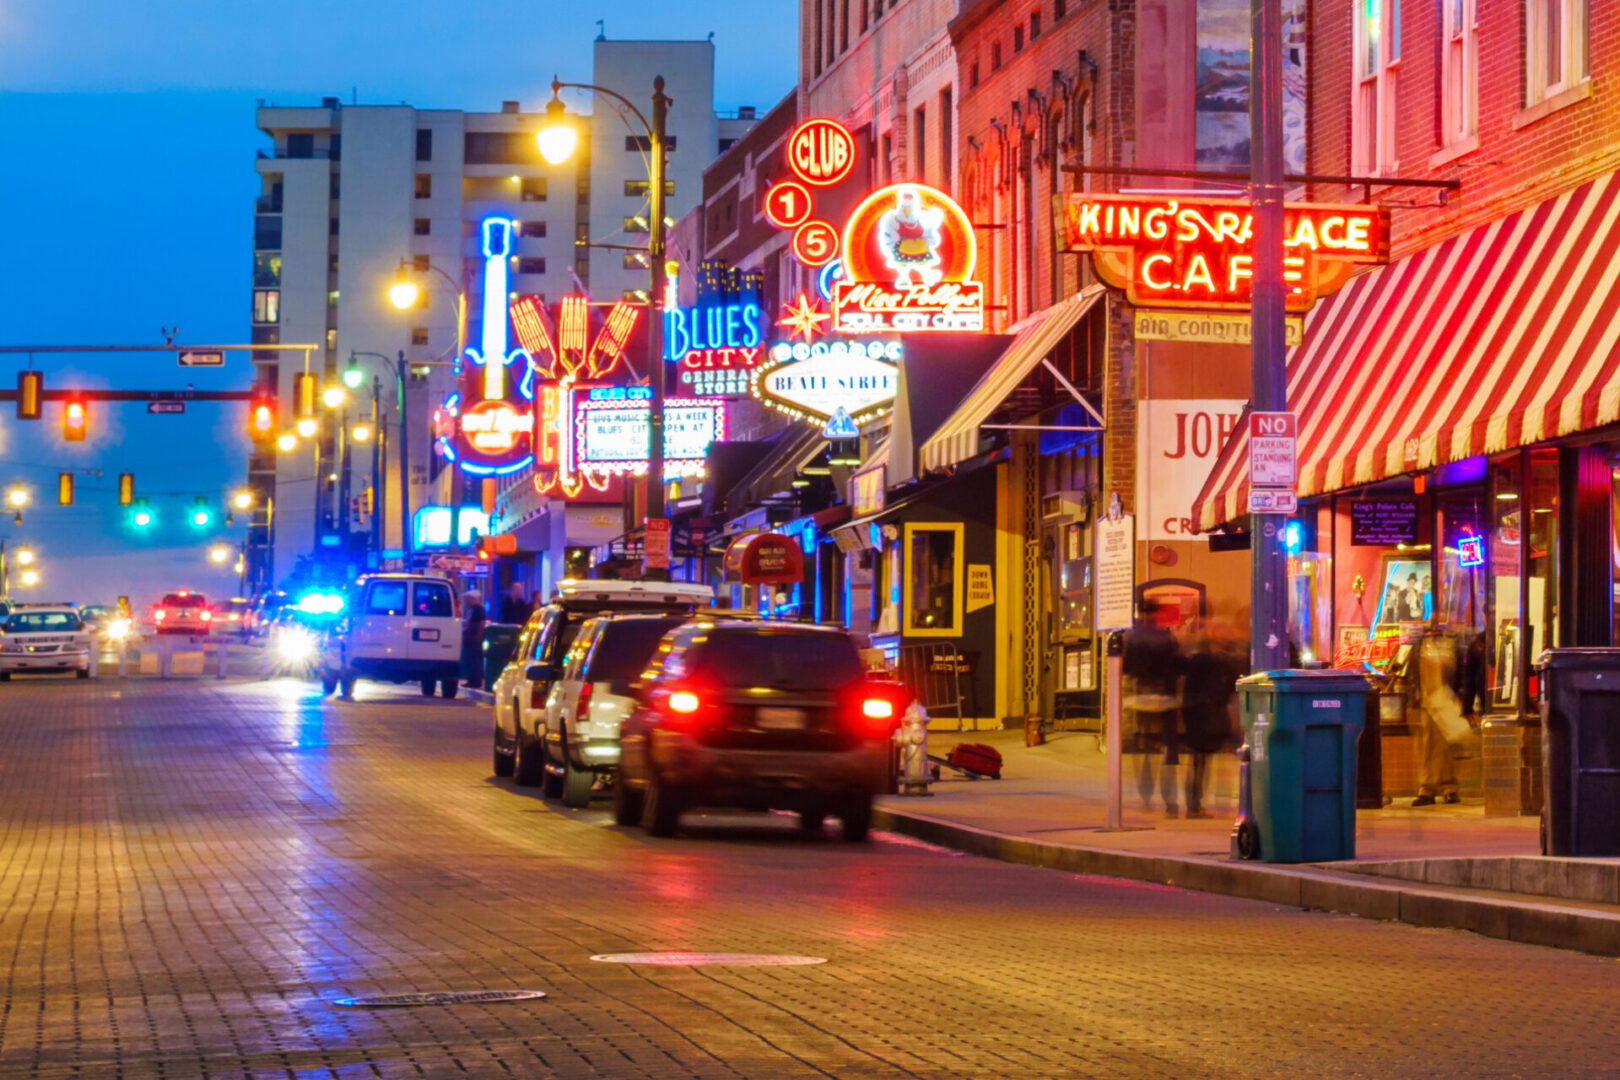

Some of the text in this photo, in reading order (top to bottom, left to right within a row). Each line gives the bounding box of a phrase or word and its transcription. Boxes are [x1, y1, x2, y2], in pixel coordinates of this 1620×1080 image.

[795, 127, 847, 177] CLUB
[779, 191, 795, 219] 1
[1078, 200, 1371, 250] KING'S PAACE
[805, 229, 827, 257] 5
[1141, 254, 1305, 294] CAFE
[840, 284, 902, 309] Miss
[670, 304, 760, 361] BLUES
[1139, 318, 1297, 340] AIR CONDITID
[684, 348, 759, 368] CITY
[693, 381, 748, 396] STORE
[775, 374, 889, 391] BEALE STREE
[685, 411, 708, 421] WEEK
[1258, 417, 1288, 434] NO
[1253, 439, 1291, 450] PARKING
[1253, 453, 1293, 464] STANDING
[1254, 463, 1267, 473] AN
[650, 521, 665, 530] NO
